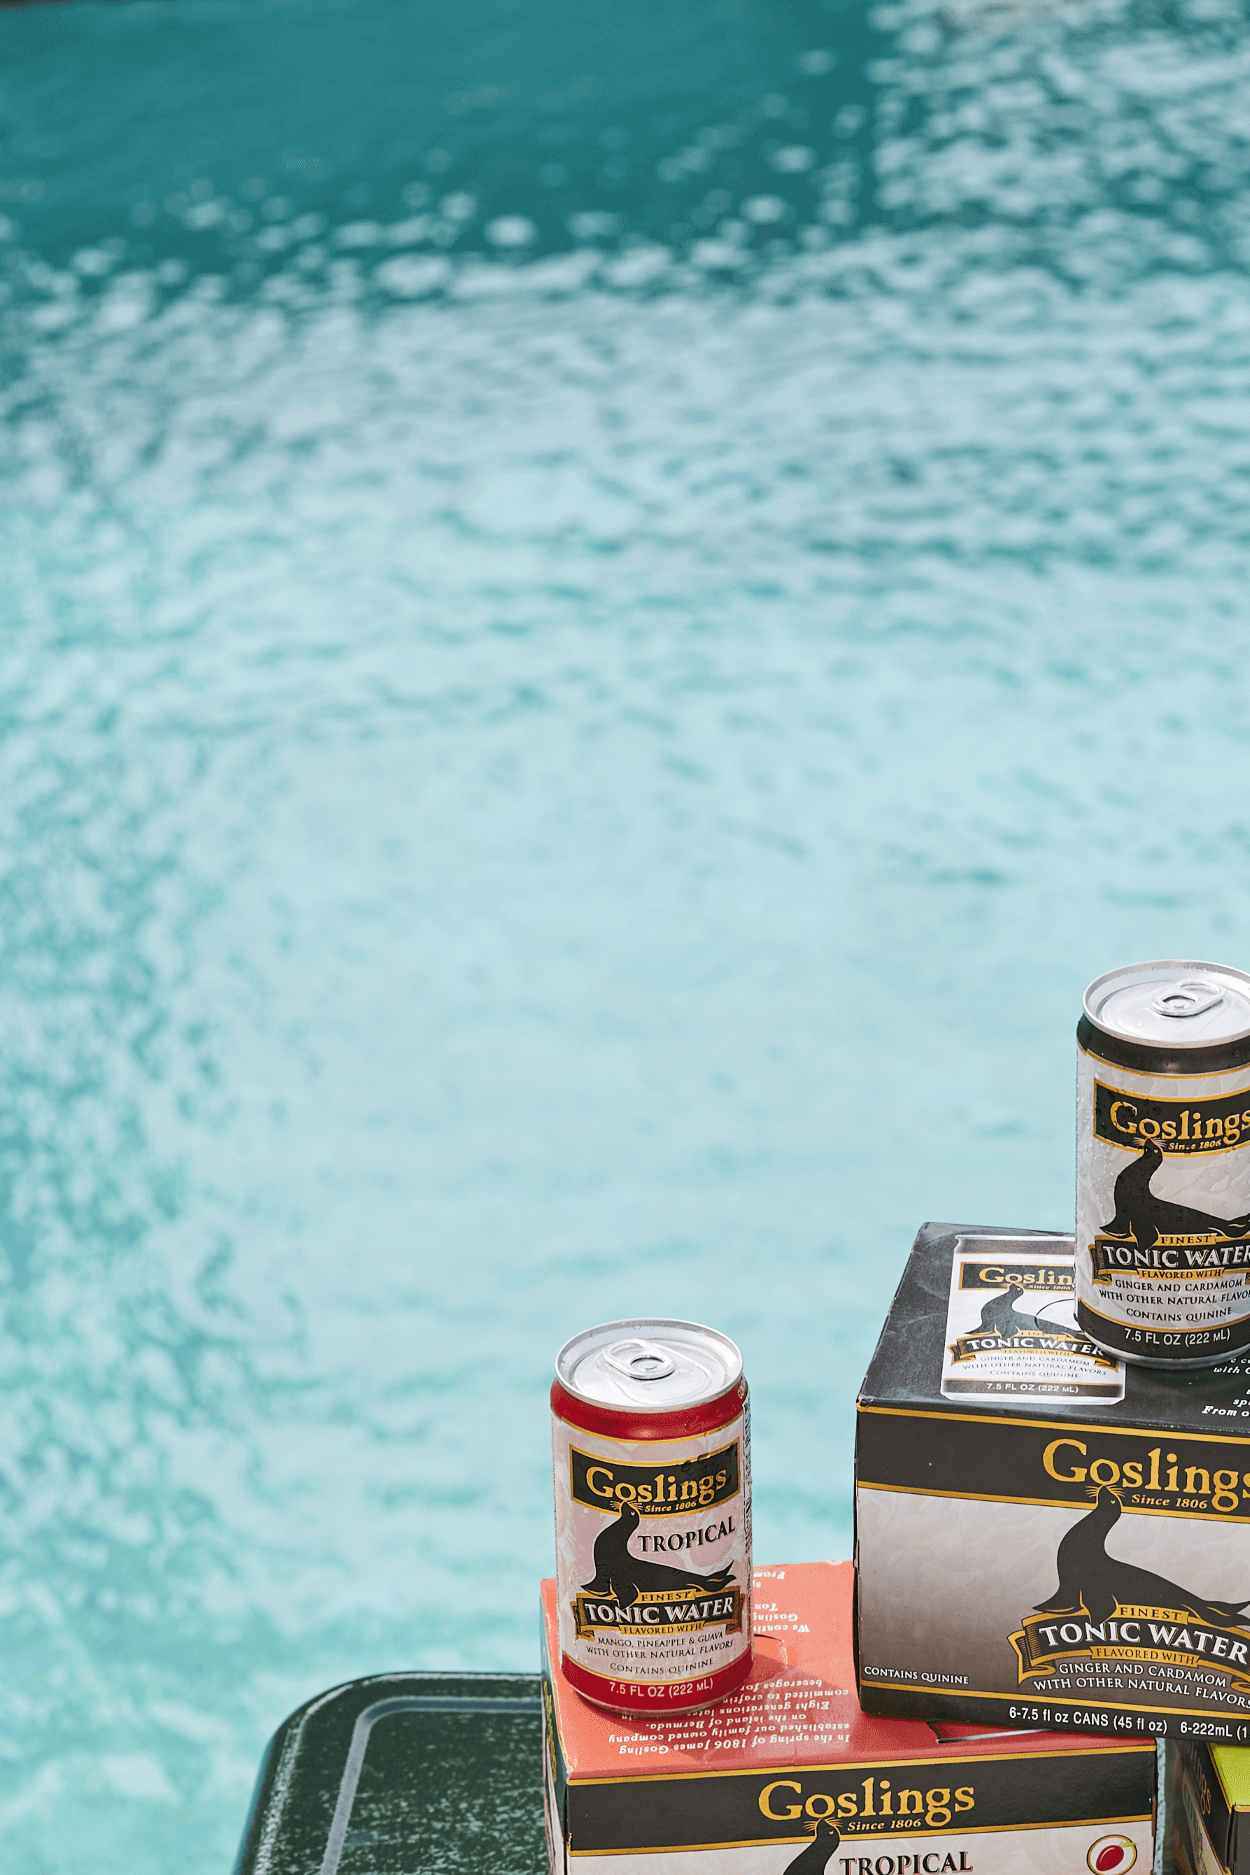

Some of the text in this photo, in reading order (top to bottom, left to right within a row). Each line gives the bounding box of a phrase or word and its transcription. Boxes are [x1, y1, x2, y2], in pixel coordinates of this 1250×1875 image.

[1199, 1139, 1221, 1149] 1806
[1162, 1236, 1210, 1244] FINEST
[1103, 1246, 1179, 1268] TONIC
[979, 1267, 1076, 1287] Goslin
[1115, 1280, 1153, 1291] GINGER
[1185, 1279, 1242, 1291] CARDAMOM
[1099, 1290, 1122, 1300] WITH
[1127, 1295, 1162, 1304] OTHER
[1168, 1295, 1217, 1305] NATURAL
[1127, 1307, 1231, 1322] CONTAINS QUININE
[967, 1338, 1034, 1350] TONIC
[1125, 1328, 1141, 1341] 7.5
[1146, 1334, 1159, 1344] FL
[1164, 1334, 1180, 1344] OZ
[1185, 1333, 1209, 1347] (222
[1202, 1406, 1237, 1416] From
[586, 1467, 727, 1504] Goslings
[645, 1502, 697, 1513] Since 1806
[1132, 1494, 1208, 1509] Since 1806
[638, 1516, 735, 1552] TROPICAL
[585, 1597, 733, 1623] TONIC WATER
[1120, 1607, 1182, 1620] FINEST
[598, 1632, 723, 1647] MANGO, PINEAPPLE GUAVA
[1039, 1622, 1248, 1665] TONIC WATER
[586, 1639, 734, 1658] WITH OTHER NATURAL FLAVORS
[1096, 1648, 1195, 1665] FLAVORED WITH
[864, 1667, 969, 1684] CONTAINS QUININE
[1059, 1663, 1226, 1687] GINGER AND CARDAMOM
[610, 1682, 625, 1693] 7.5
[631, 1685, 644, 1696] FL
[648, 1686, 665, 1697] OZ
[669, 1683, 693, 1698] (222
[1034, 1678, 1071, 1691] WITH
[1077, 1678, 1123, 1688] OTHER
[1128, 1680, 1189, 1695] NATURAL
[1009, 1707, 1038, 1721] 6-7.5
[1043, 1709, 1051, 1721] fl
[1055, 1713, 1068, 1723] oz
[1074, 1712, 1108, 1727] CANS
[1114, 1715, 1133, 1730] (45
[1137, 1717, 1144, 1729] fl
[1149, 1720, 1167, 1734] oz)
[1180, 1722, 1232, 1737] 6-222mL
[619, 1733, 849, 1754] In the spring of 1806 James Gosling
[759, 1777, 975, 1826] Goslings
[847, 1819, 921, 1831] Since 1806
